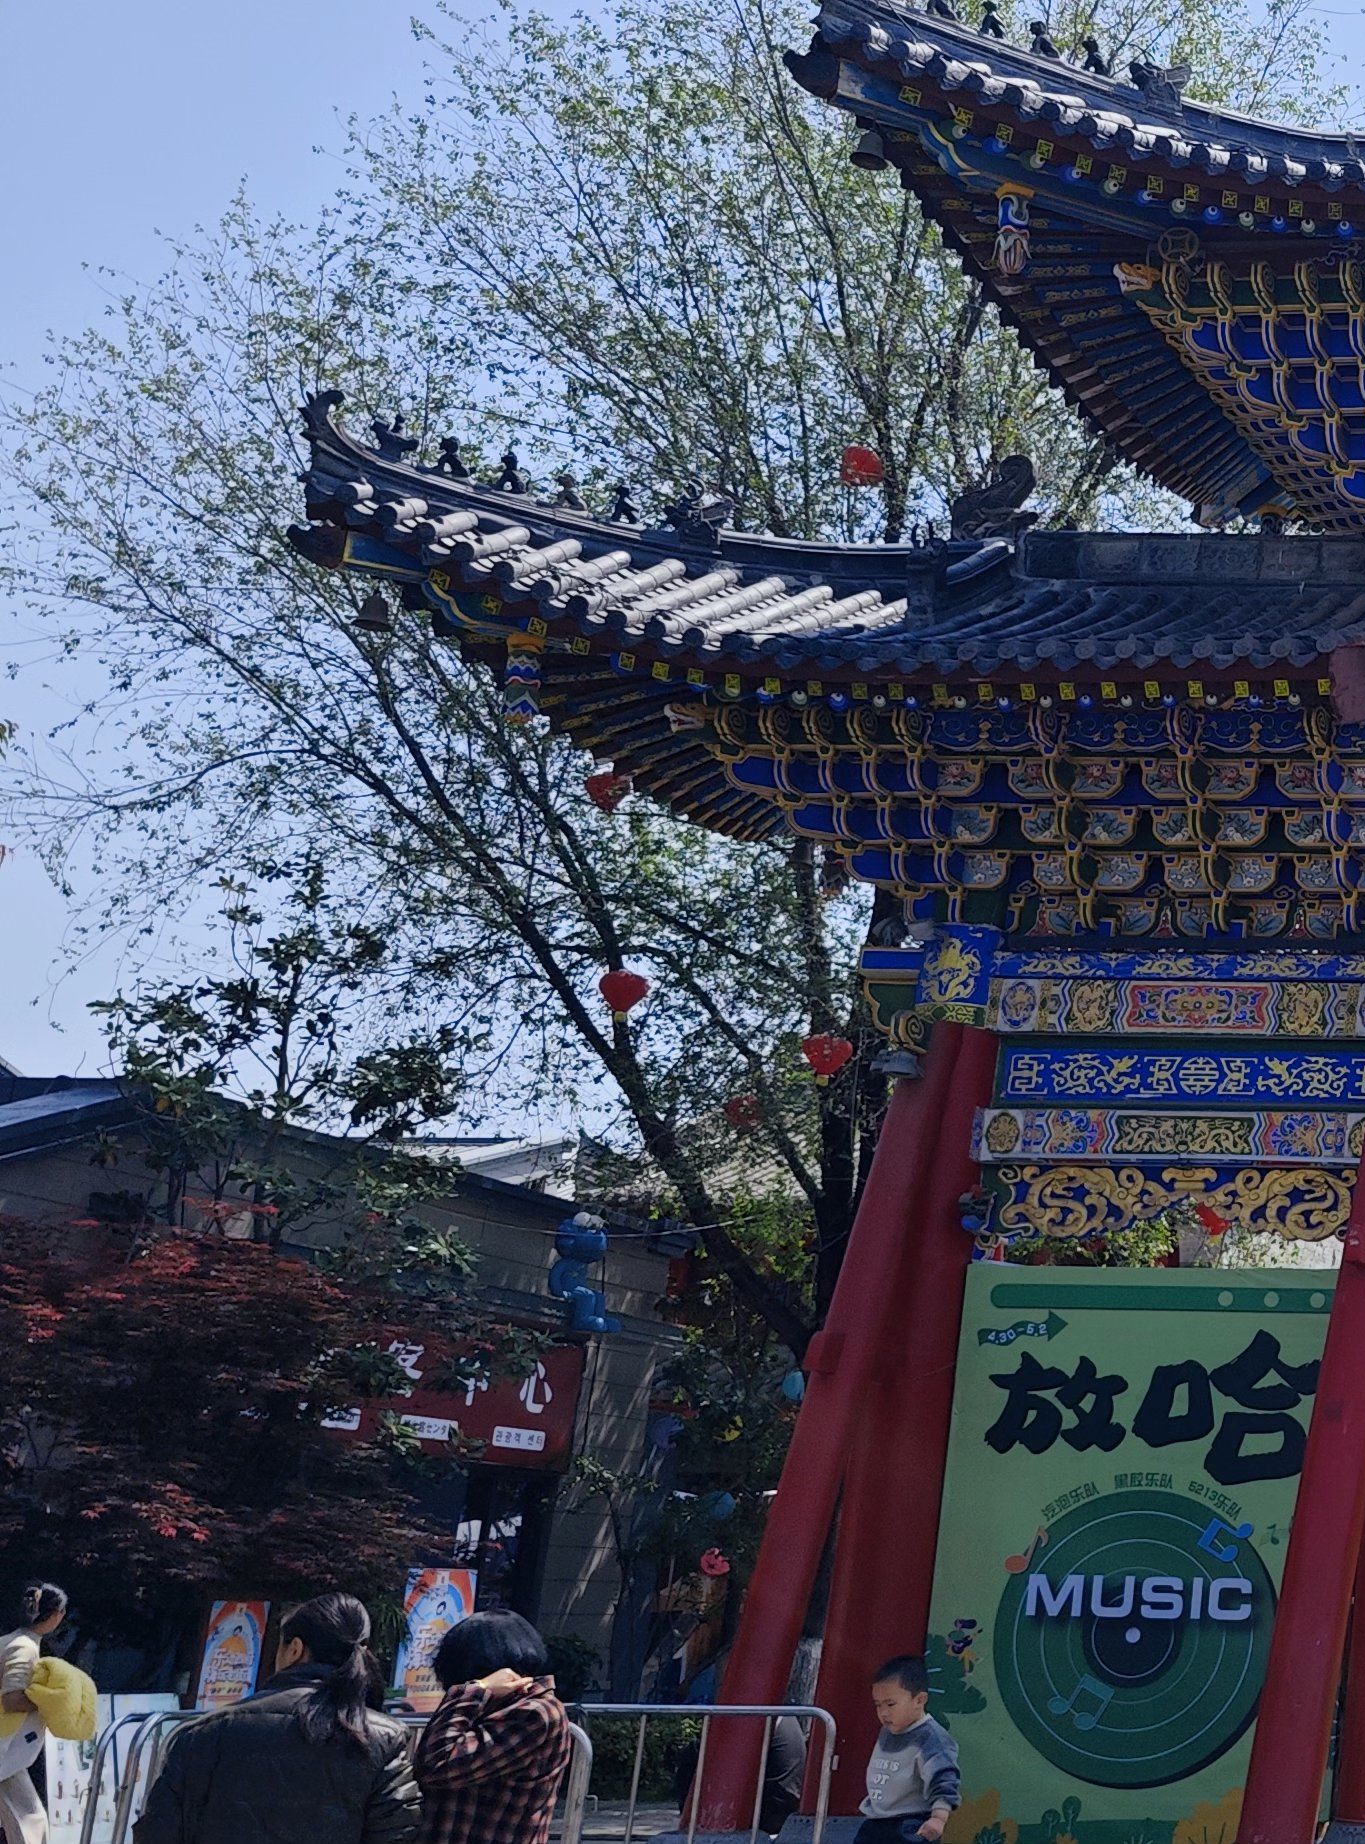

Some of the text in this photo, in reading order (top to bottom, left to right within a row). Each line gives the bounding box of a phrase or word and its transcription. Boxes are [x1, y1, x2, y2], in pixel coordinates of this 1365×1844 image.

[983, 1329, 1324, 1486] 放哈
[1114, 1472, 1174, 1490] 黑胶乐队
[1188, 1480, 1243, 1521] 5213乐队
[1025, 1573, 1253, 1621] MUSIC
